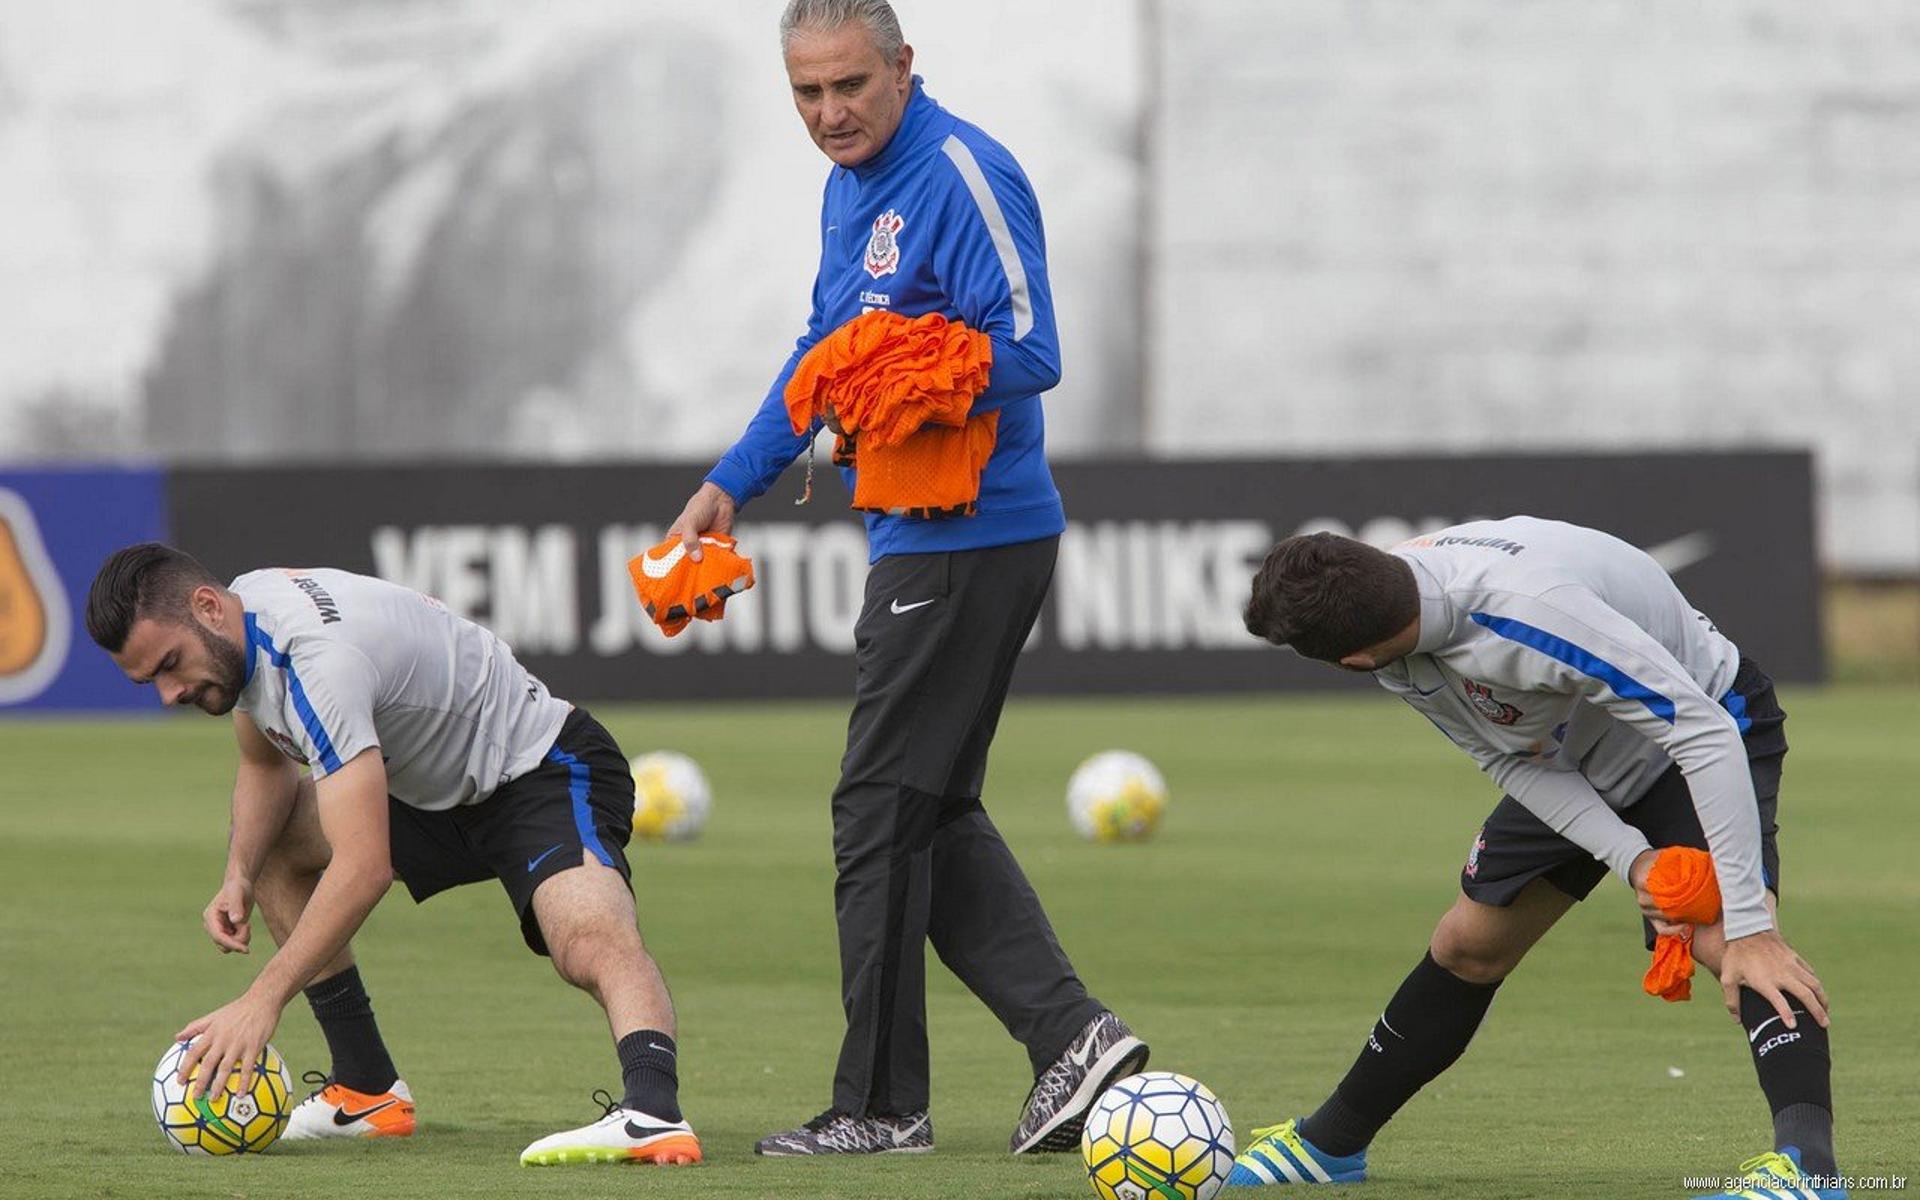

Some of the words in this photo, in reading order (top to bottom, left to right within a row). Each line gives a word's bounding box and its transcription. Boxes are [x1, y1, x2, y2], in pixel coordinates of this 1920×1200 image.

[371, 523, 579, 655] VEM
[588, 519, 868, 656] JTO
[1056, 519, 1274, 651] NIKE
[1758, 1031, 1801, 1057] SCCP
